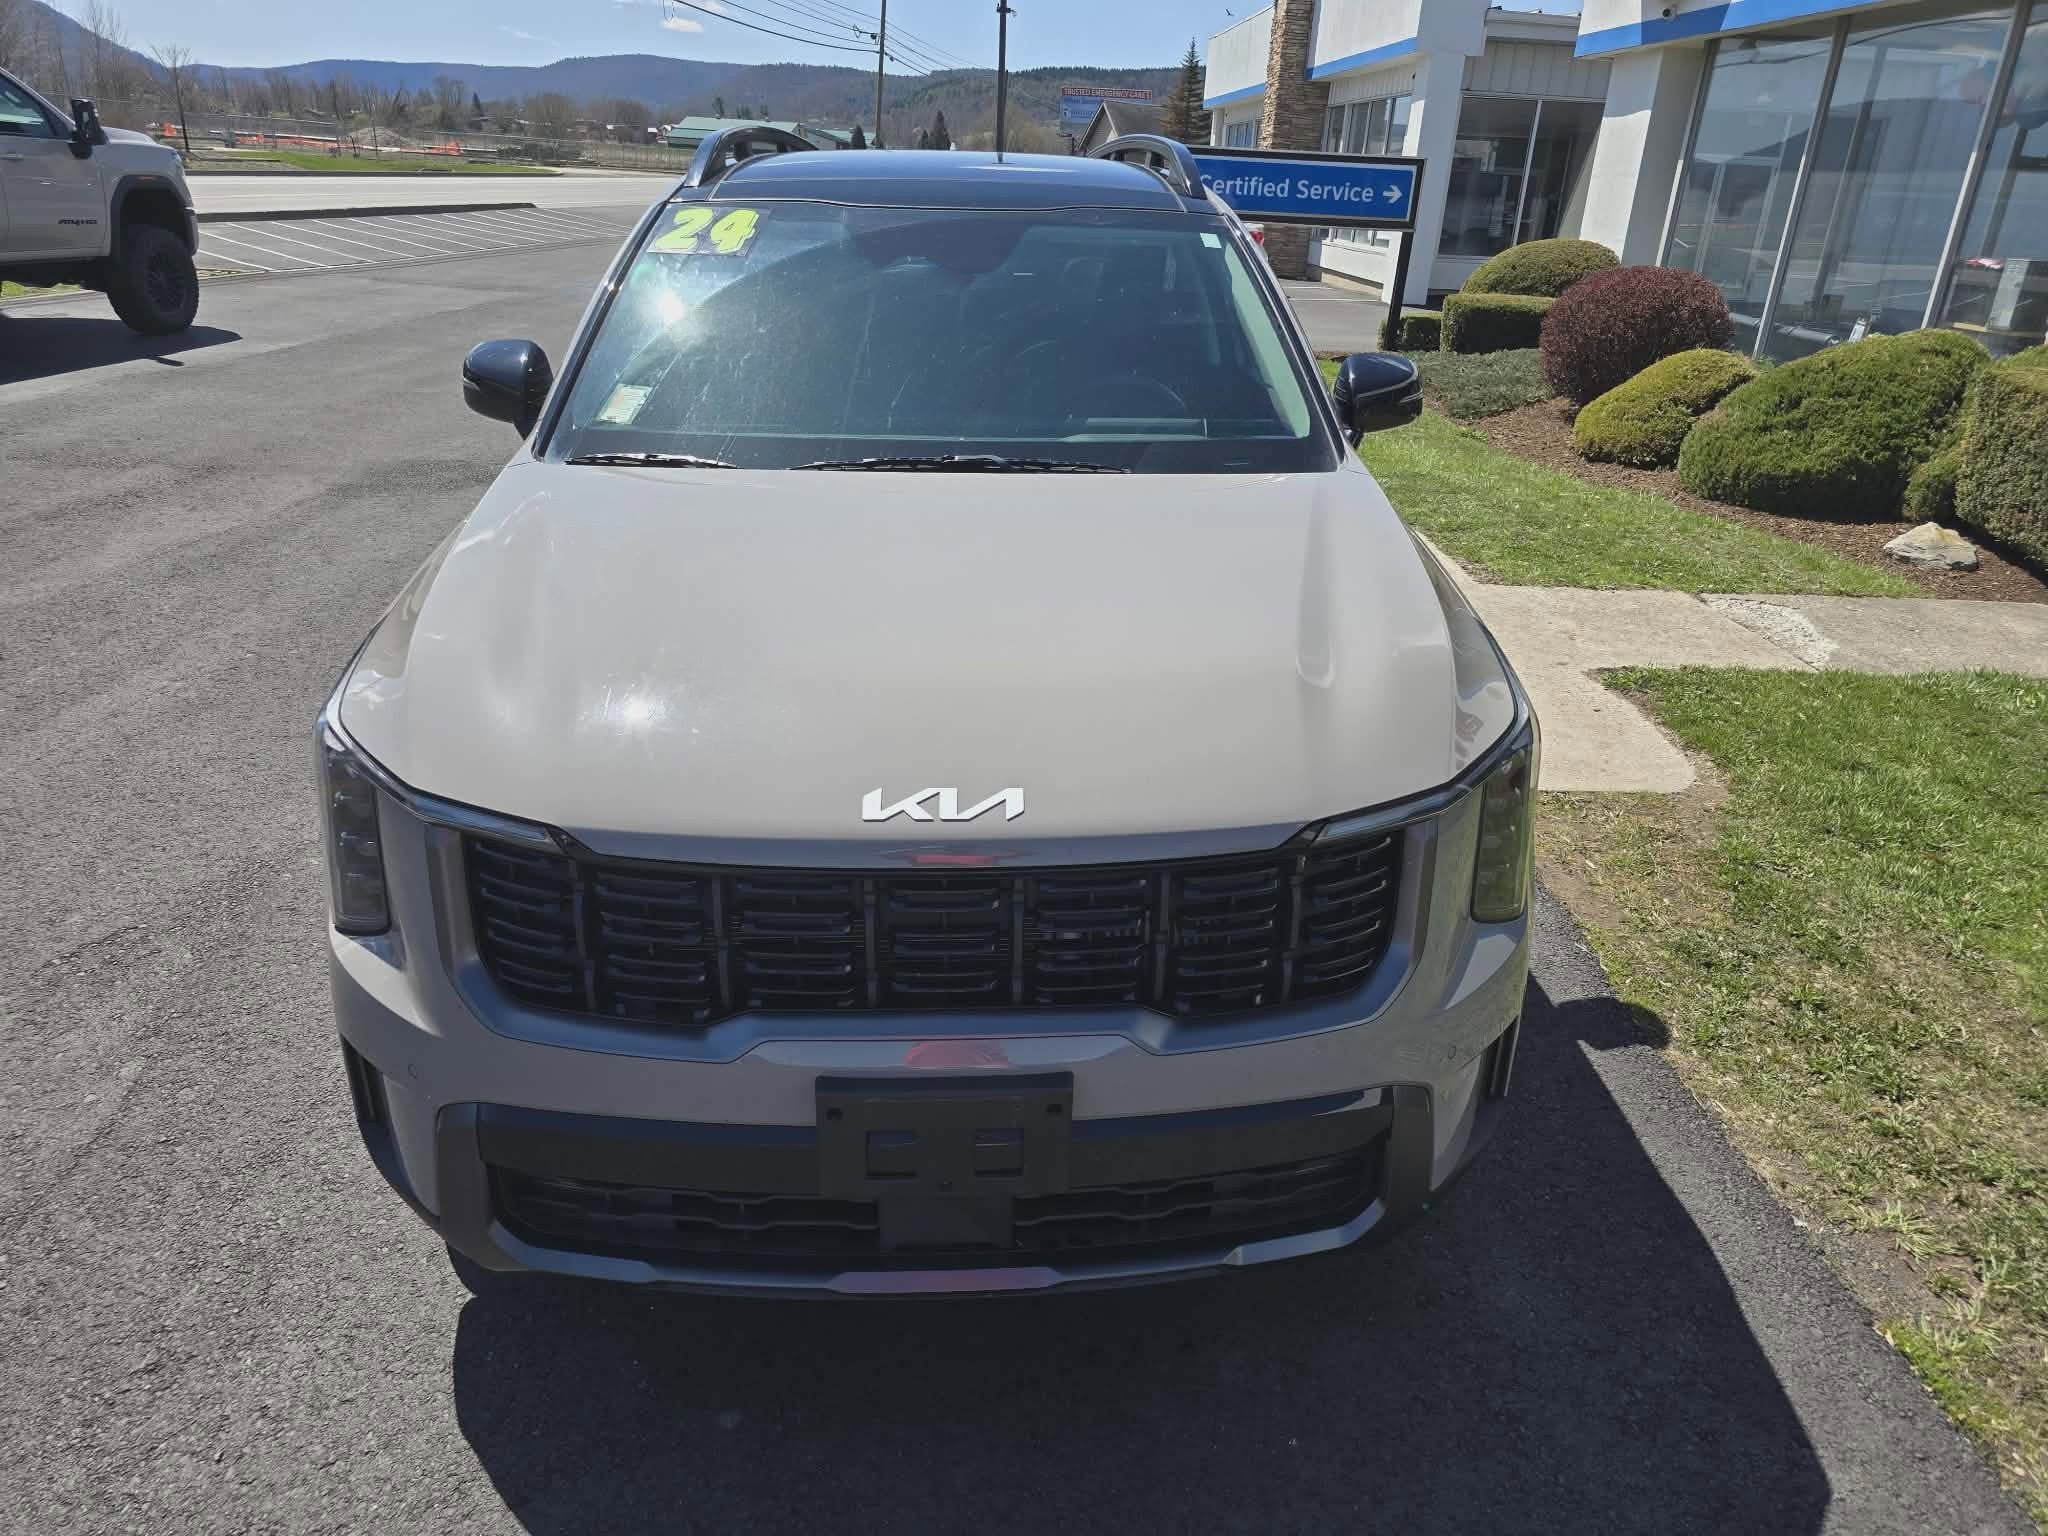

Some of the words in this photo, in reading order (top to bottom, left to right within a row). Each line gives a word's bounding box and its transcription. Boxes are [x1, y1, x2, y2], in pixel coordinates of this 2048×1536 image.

[1295, 179, 1374, 202] Service
[655, 208, 759, 253] 24
[862, 787, 1024, 822] KIA
